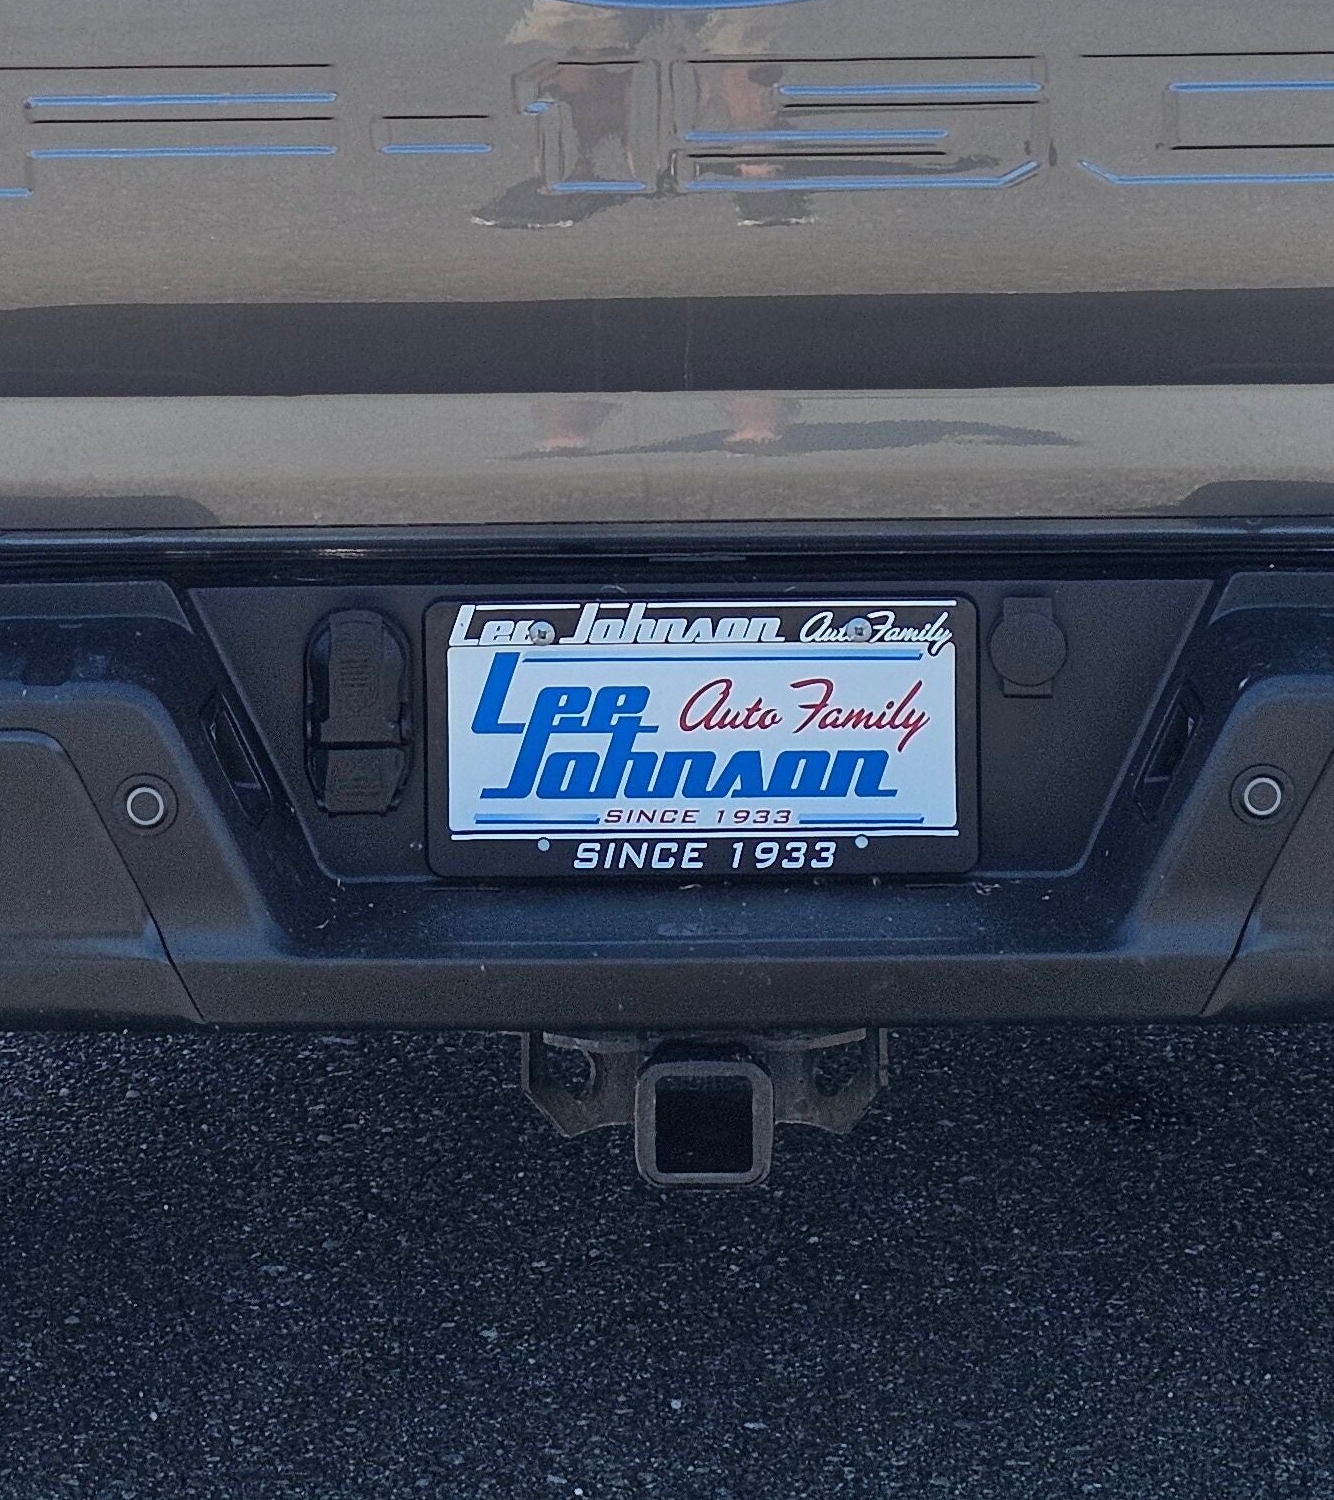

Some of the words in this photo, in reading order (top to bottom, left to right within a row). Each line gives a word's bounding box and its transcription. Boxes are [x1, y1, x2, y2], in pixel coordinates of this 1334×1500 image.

[559, 602, 786, 644] Johnson
[867, 610, 953, 655] Family
[471, 651, 660, 735] Lee
[679, 677, 783, 732] Auto
[789, 677, 931, 753] Family
[479, 718, 898, 799] Johnson
[603, 809, 701, 824] SINCE
[717, 809, 792, 824] 1933
[573, 841, 708, 869] SINCE
[732, 841, 837, 869] 1933
